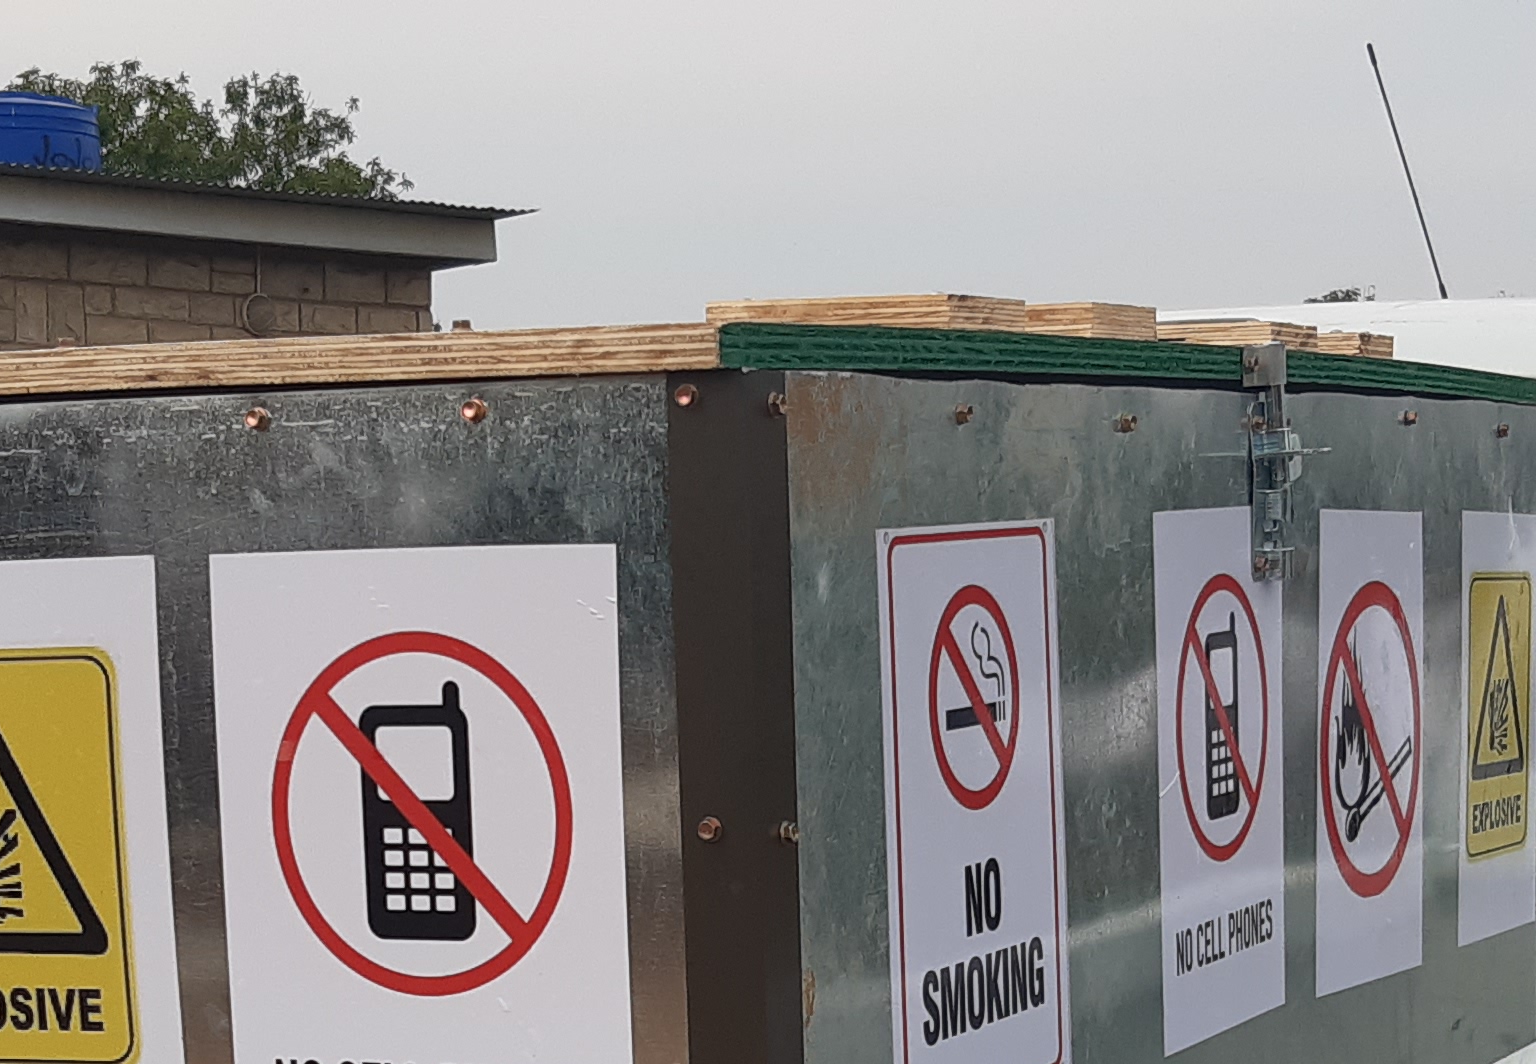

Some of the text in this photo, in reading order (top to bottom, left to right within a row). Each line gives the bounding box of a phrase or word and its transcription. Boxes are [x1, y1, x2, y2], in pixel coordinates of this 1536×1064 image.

[1472, 794, 1522, 834] EXPLOSIVE
[964, 857, 1002, 937] NO
[1176, 898, 1273, 977] NO CELL PHONES
[922, 936, 1045, 1046] SMOKING
